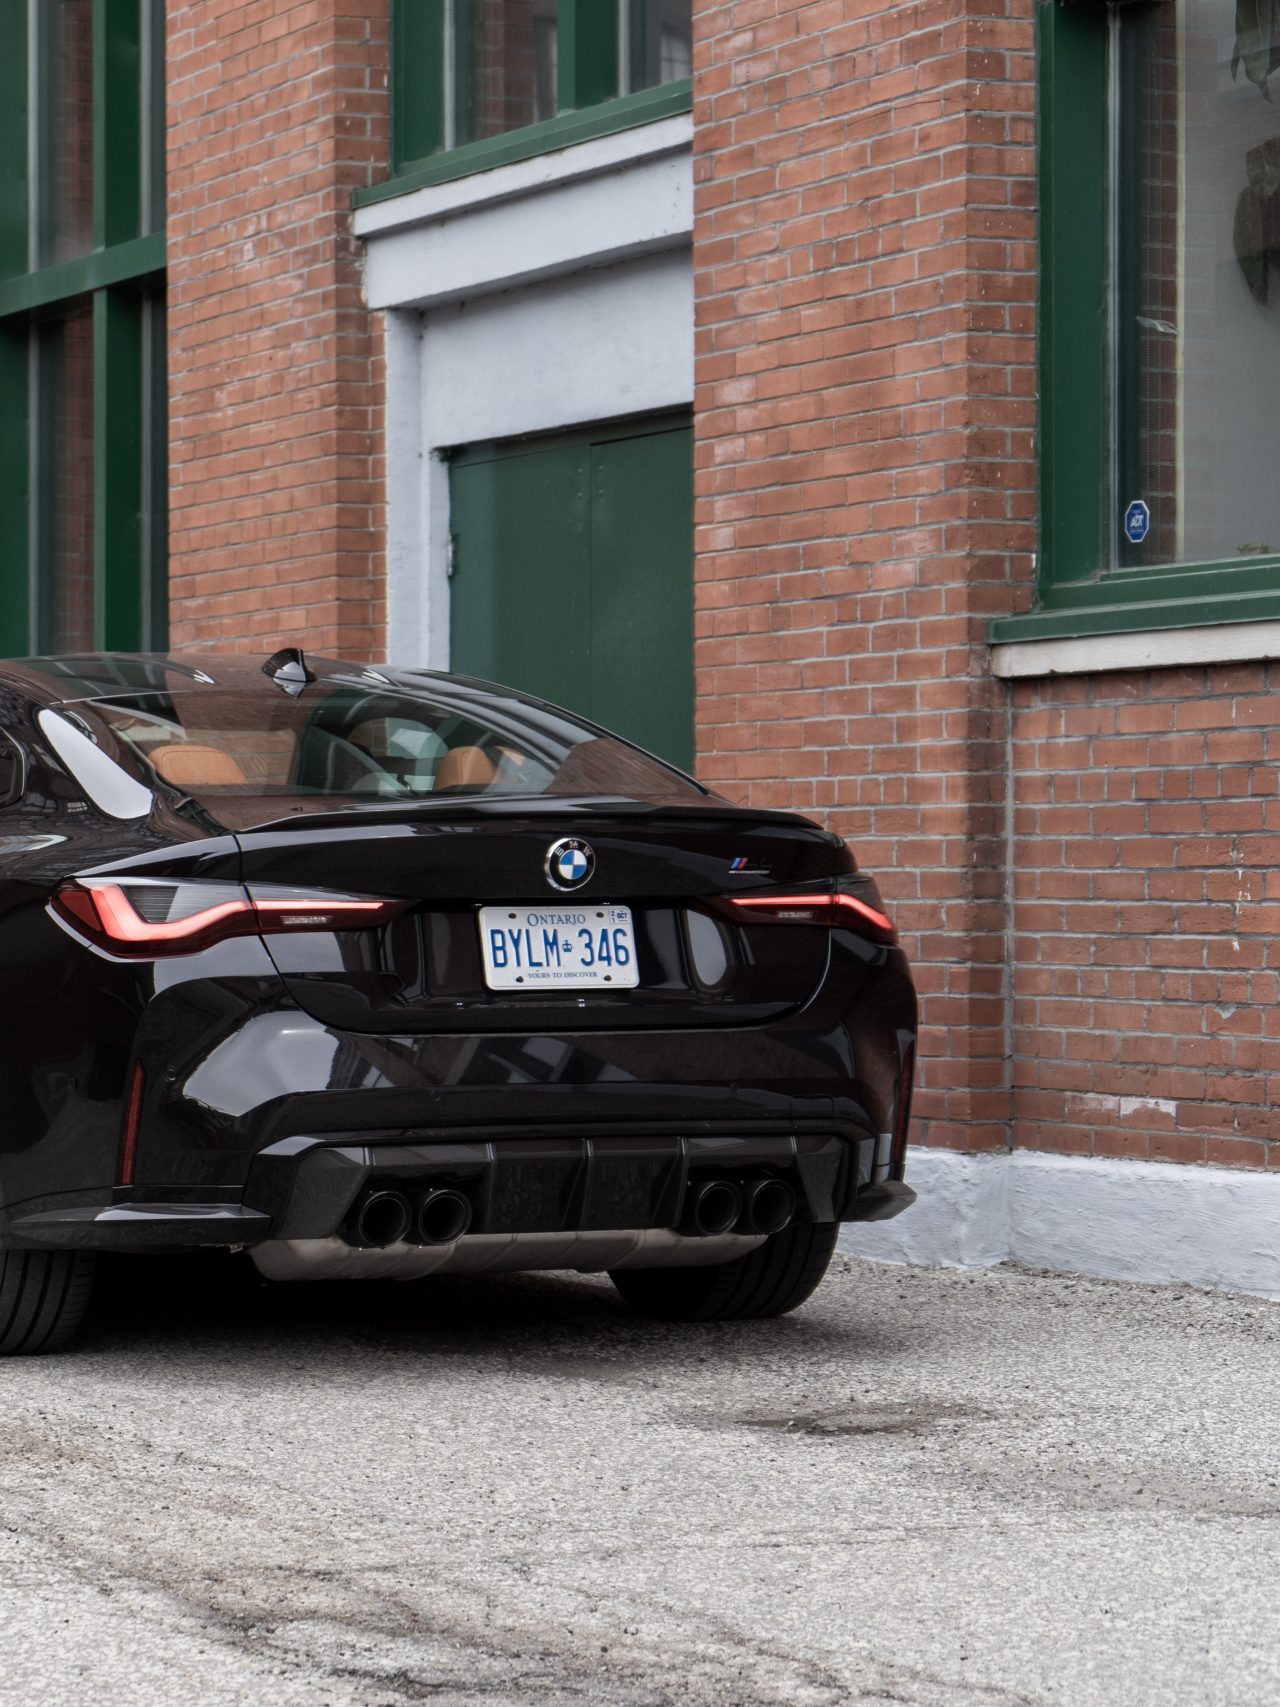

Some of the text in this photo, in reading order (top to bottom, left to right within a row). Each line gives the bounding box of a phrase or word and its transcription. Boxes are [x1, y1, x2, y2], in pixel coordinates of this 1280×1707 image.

[1130, 515, 1144, 527] ADT
[555, 841, 592, 856] BMW
[527, 913, 586, 926] ONTARIO
[490, 928, 630, 968] BYLM 346
